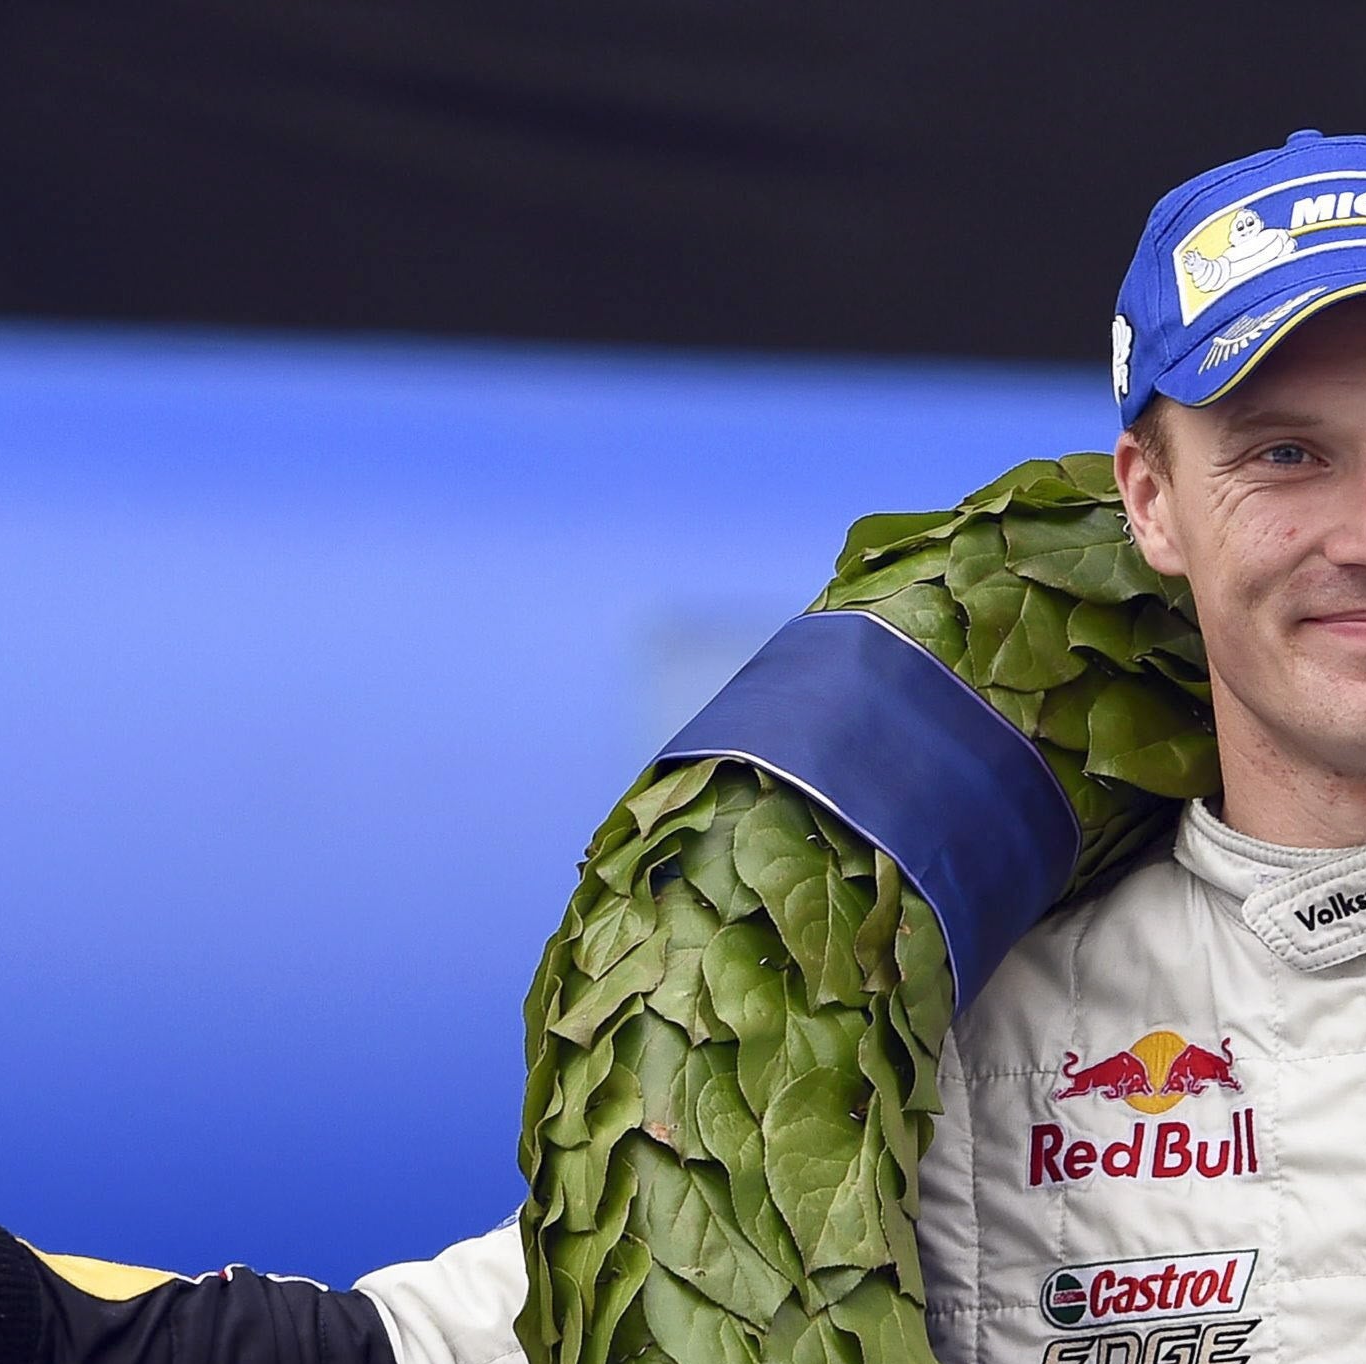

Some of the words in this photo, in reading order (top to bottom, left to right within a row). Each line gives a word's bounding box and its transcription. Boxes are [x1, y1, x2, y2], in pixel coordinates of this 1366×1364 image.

[1030, 1122, 1145, 1186] Red
[1151, 1108, 1257, 1178] Bull
[1089, 1258, 1237, 1318] Castrol
